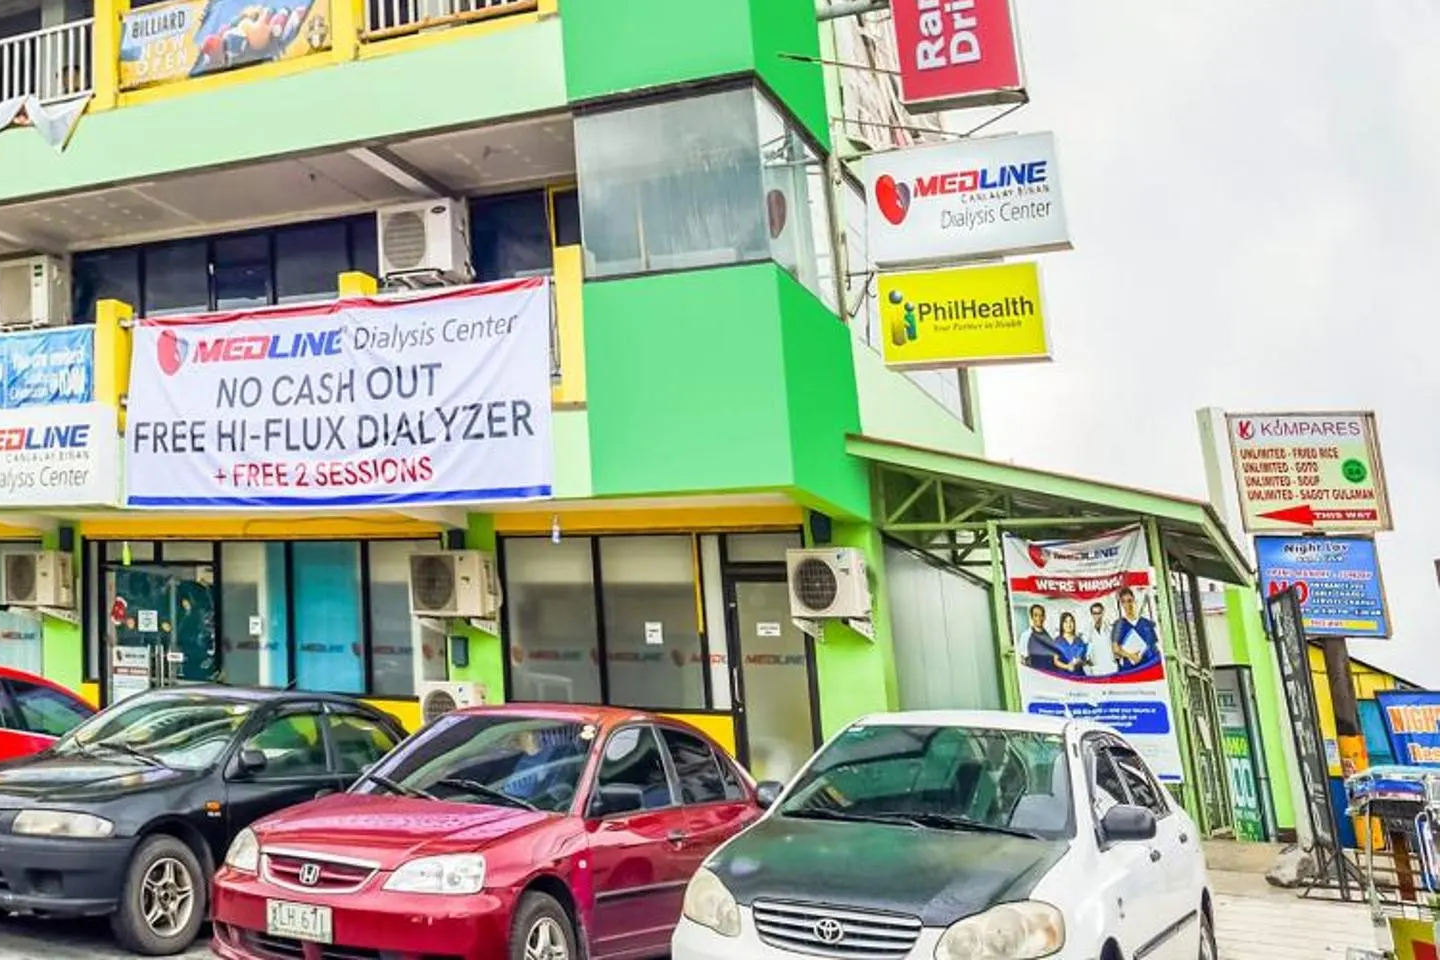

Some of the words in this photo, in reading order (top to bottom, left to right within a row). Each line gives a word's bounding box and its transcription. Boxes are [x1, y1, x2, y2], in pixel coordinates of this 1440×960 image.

[132, 11, 185, 39] BILLIARD
[913, 160, 1047, 198] MEDLINE
[941, 204, 995, 230] Dialysis
[1000, 201, 1052, 222] Center
[918, 296, 1034, 322] PhilHealth
[192, 329, 344, 363] MEDLINE
[355, 322, 435, 351] Dialysis
[442, 314, 518, 343] Center
[217, 377, 261, 408] NO
[272, 371, 355, 407] CASH
[367, 363, 442, 398] OUT
[134, 421, 205, 453] FREE
[218, 415, 346, 452] HI-FLUX
[359, 400, 535, 449] DIALYZER
[1240, 448, 1286, 459] UNLIMITED
[1292, 447, 1317, 459] FRIED
[1320, 447, 1338, 458] RICE
[40, 466, 90, 487] Center
[234, 462, 287, 487] FREE
[296, 462, 310, 486] 2
[314, 457, 434, 487] SESSIONS
[1242, 462, 1288, 473] UNLIMITED
[1295, 462, 1318, 473] GOTO
[1244, 475, 1290, 486] UNLIMITED
[1297, 475, 1319, 486] SOUP
[1247, 489, 1294, 500] UNLIMITED
[1332, 489, 1375, 500] GULAMAN
[1315, 512, 1342, 520] THIS
[1283, 543, 1321, 554] Night
[1035, 577, 1076, 593] WE'RE
